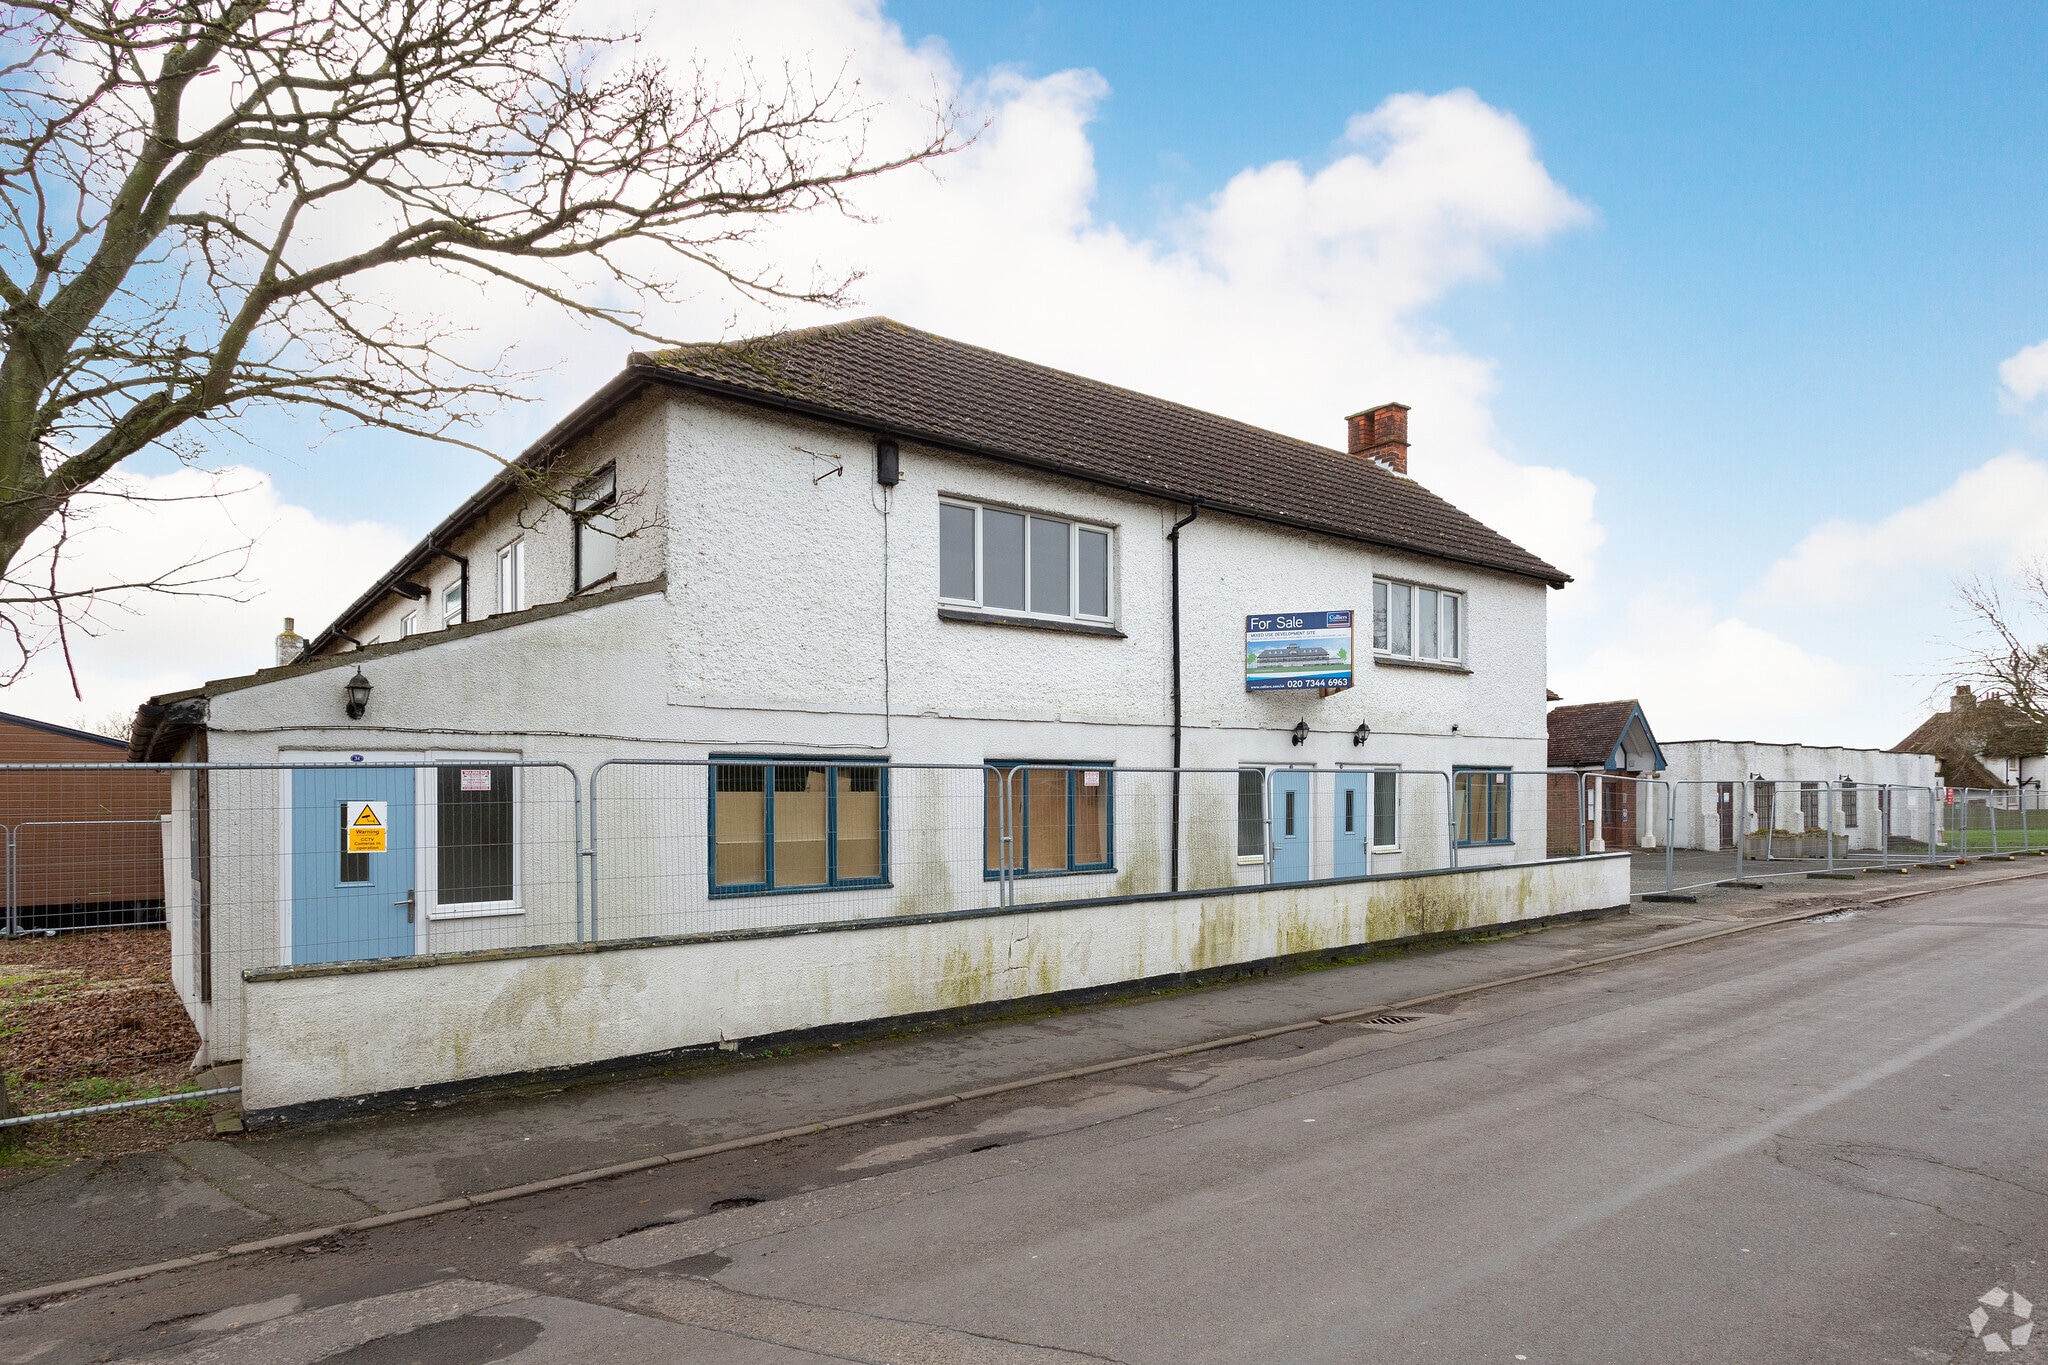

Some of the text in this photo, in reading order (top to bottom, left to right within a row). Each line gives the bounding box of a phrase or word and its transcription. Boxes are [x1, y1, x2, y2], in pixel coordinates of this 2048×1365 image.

[1250, 616, 1303, 630] For Sale
[1287, 678, 1348, 688] 020 7344 6963
